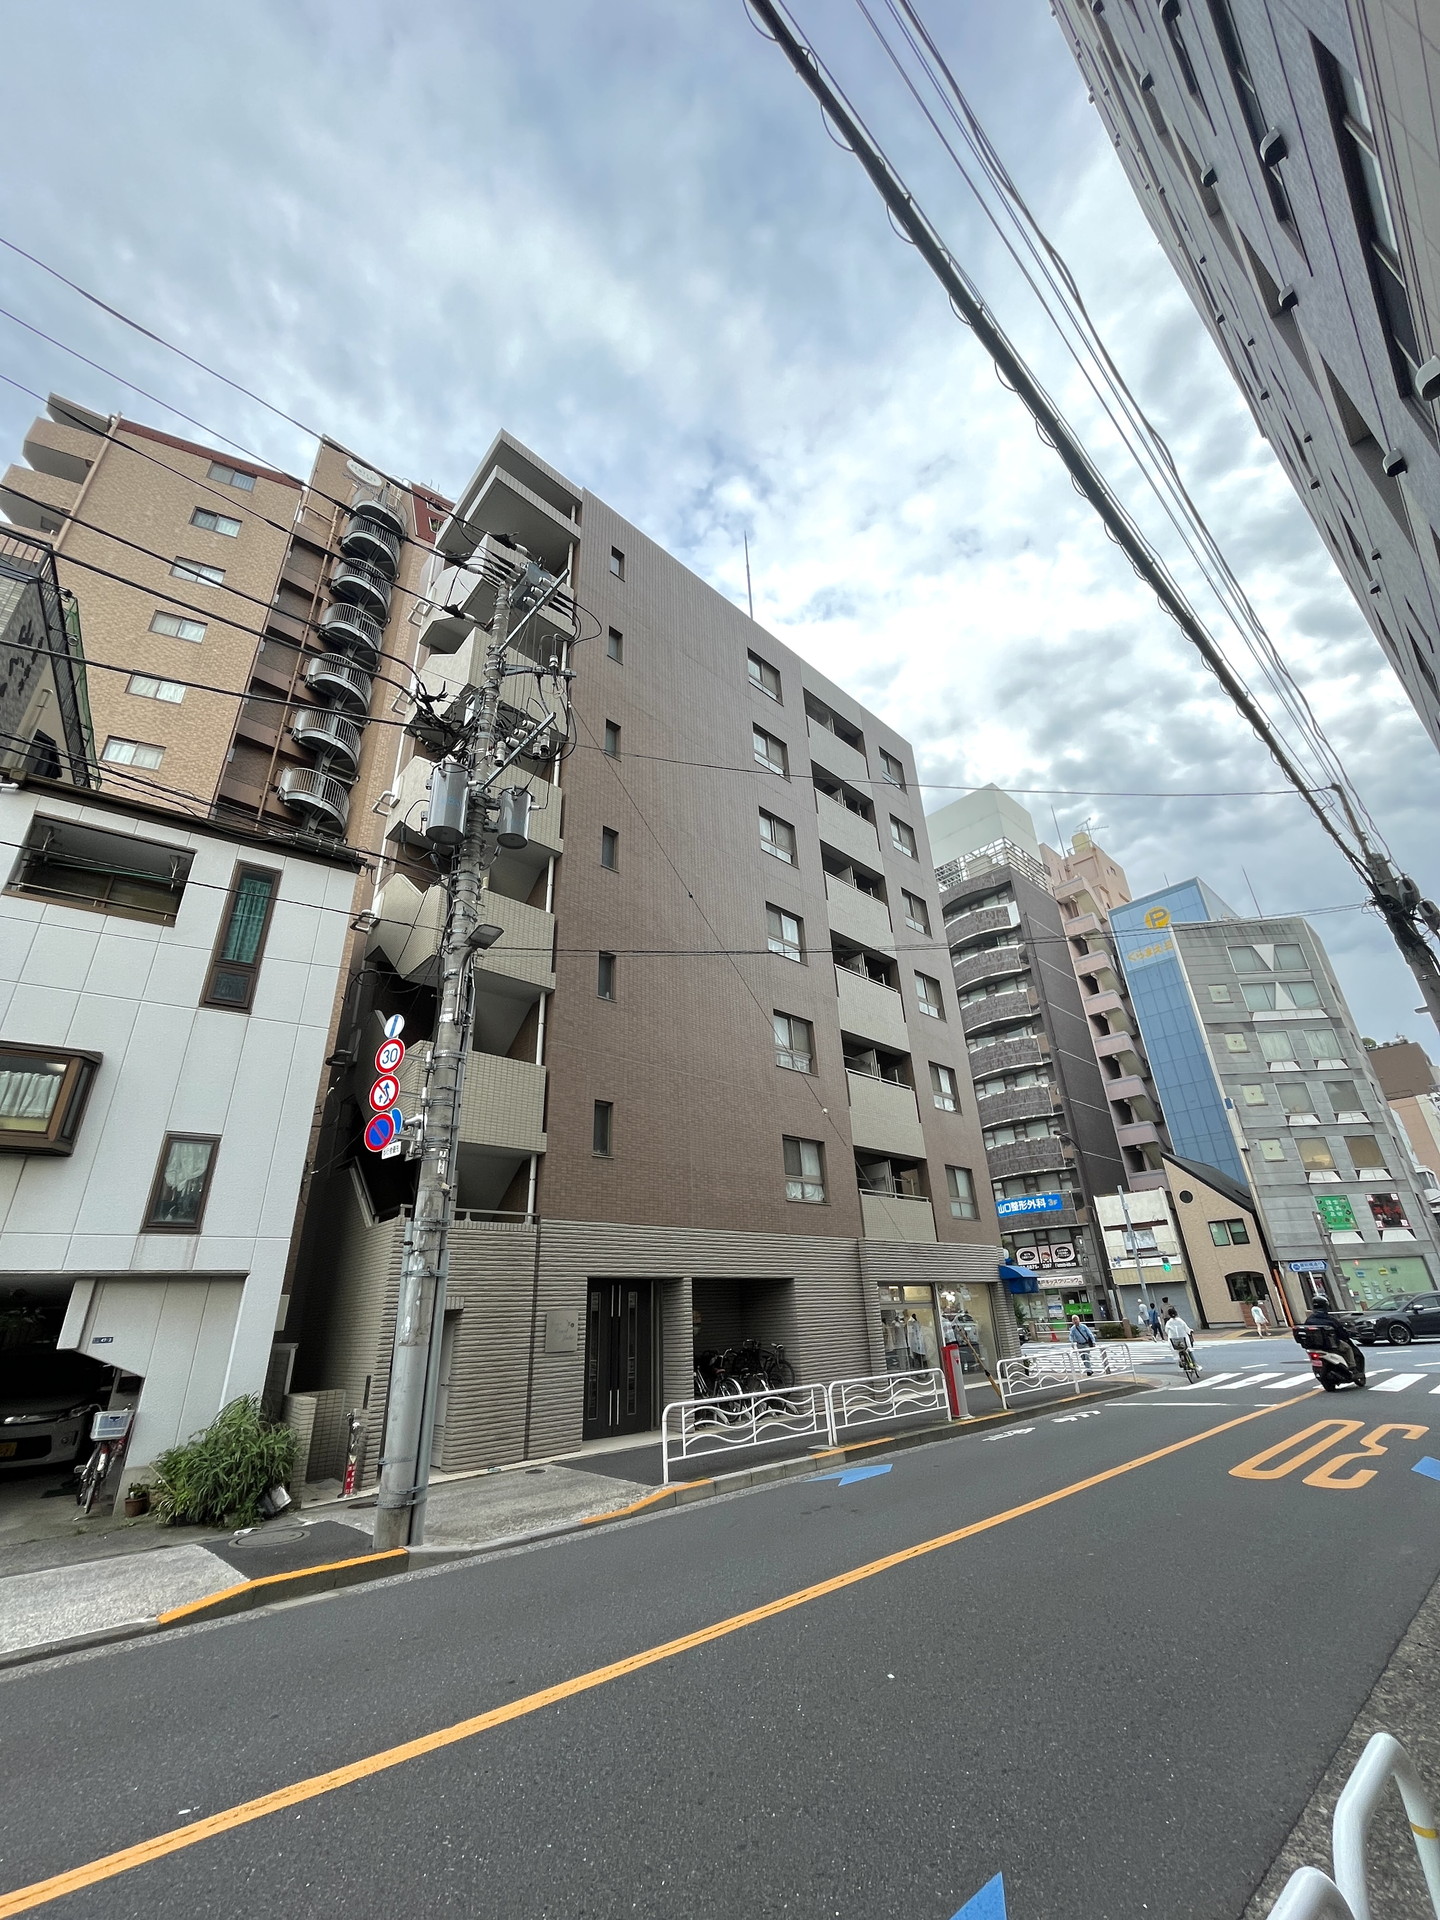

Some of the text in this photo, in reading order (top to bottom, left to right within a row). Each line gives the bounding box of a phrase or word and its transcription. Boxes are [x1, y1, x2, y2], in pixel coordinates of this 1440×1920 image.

[382, 1048, 398, 1065] 30
[998, 1197, 1058, 1214] 山口整形外科 3F
[1228, 1419, 1430, 1489] 30
